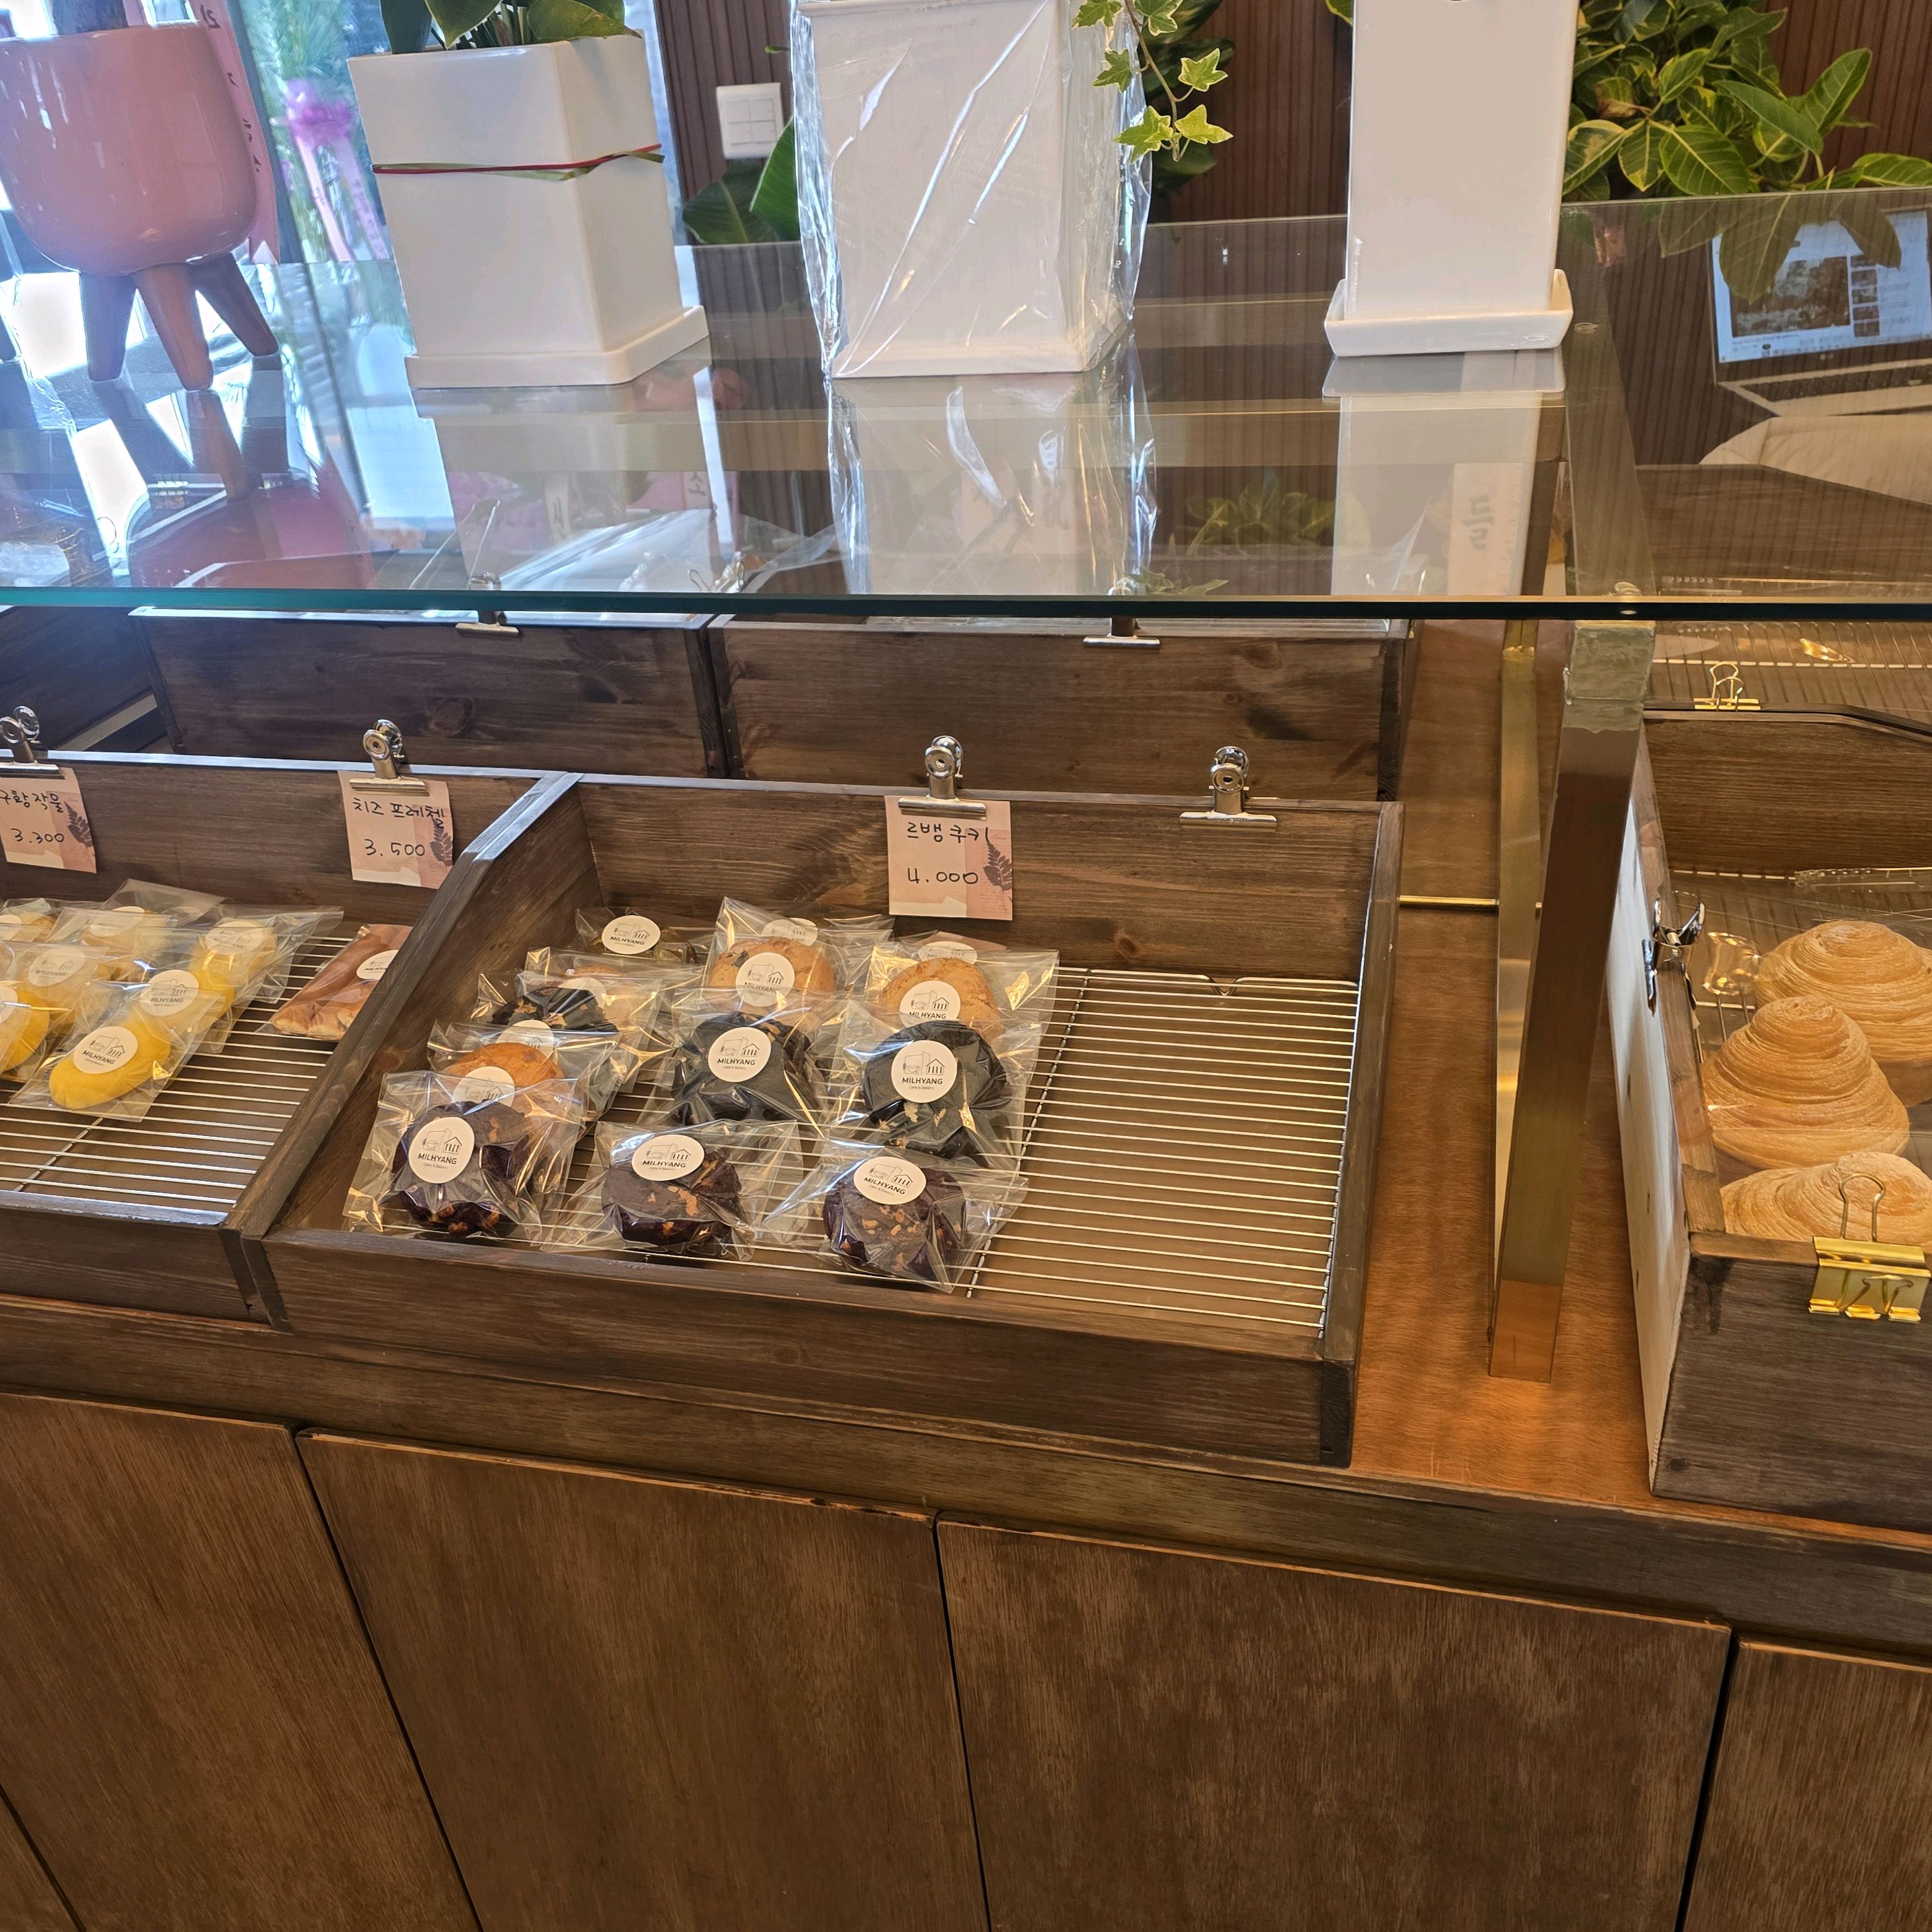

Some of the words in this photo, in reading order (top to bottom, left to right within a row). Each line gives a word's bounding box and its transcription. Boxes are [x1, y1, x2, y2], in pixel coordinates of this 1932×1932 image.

[352, 797, 384, 815] 치즈
[390, 802, 444, 828] 프레첼
[11, 828, 64, 844] 3.300
[907, 867, 978, 884] 4.000
[610, 936, 645, 945] MILHYANG
[82, 1050, 116, 1065] MILHYANG
[417, 1152, 457, 1165] MILHYANG
[642, 1160, 687, 1168] MILHYANG
[863, 1177, 907, 1195] MILHYANG
